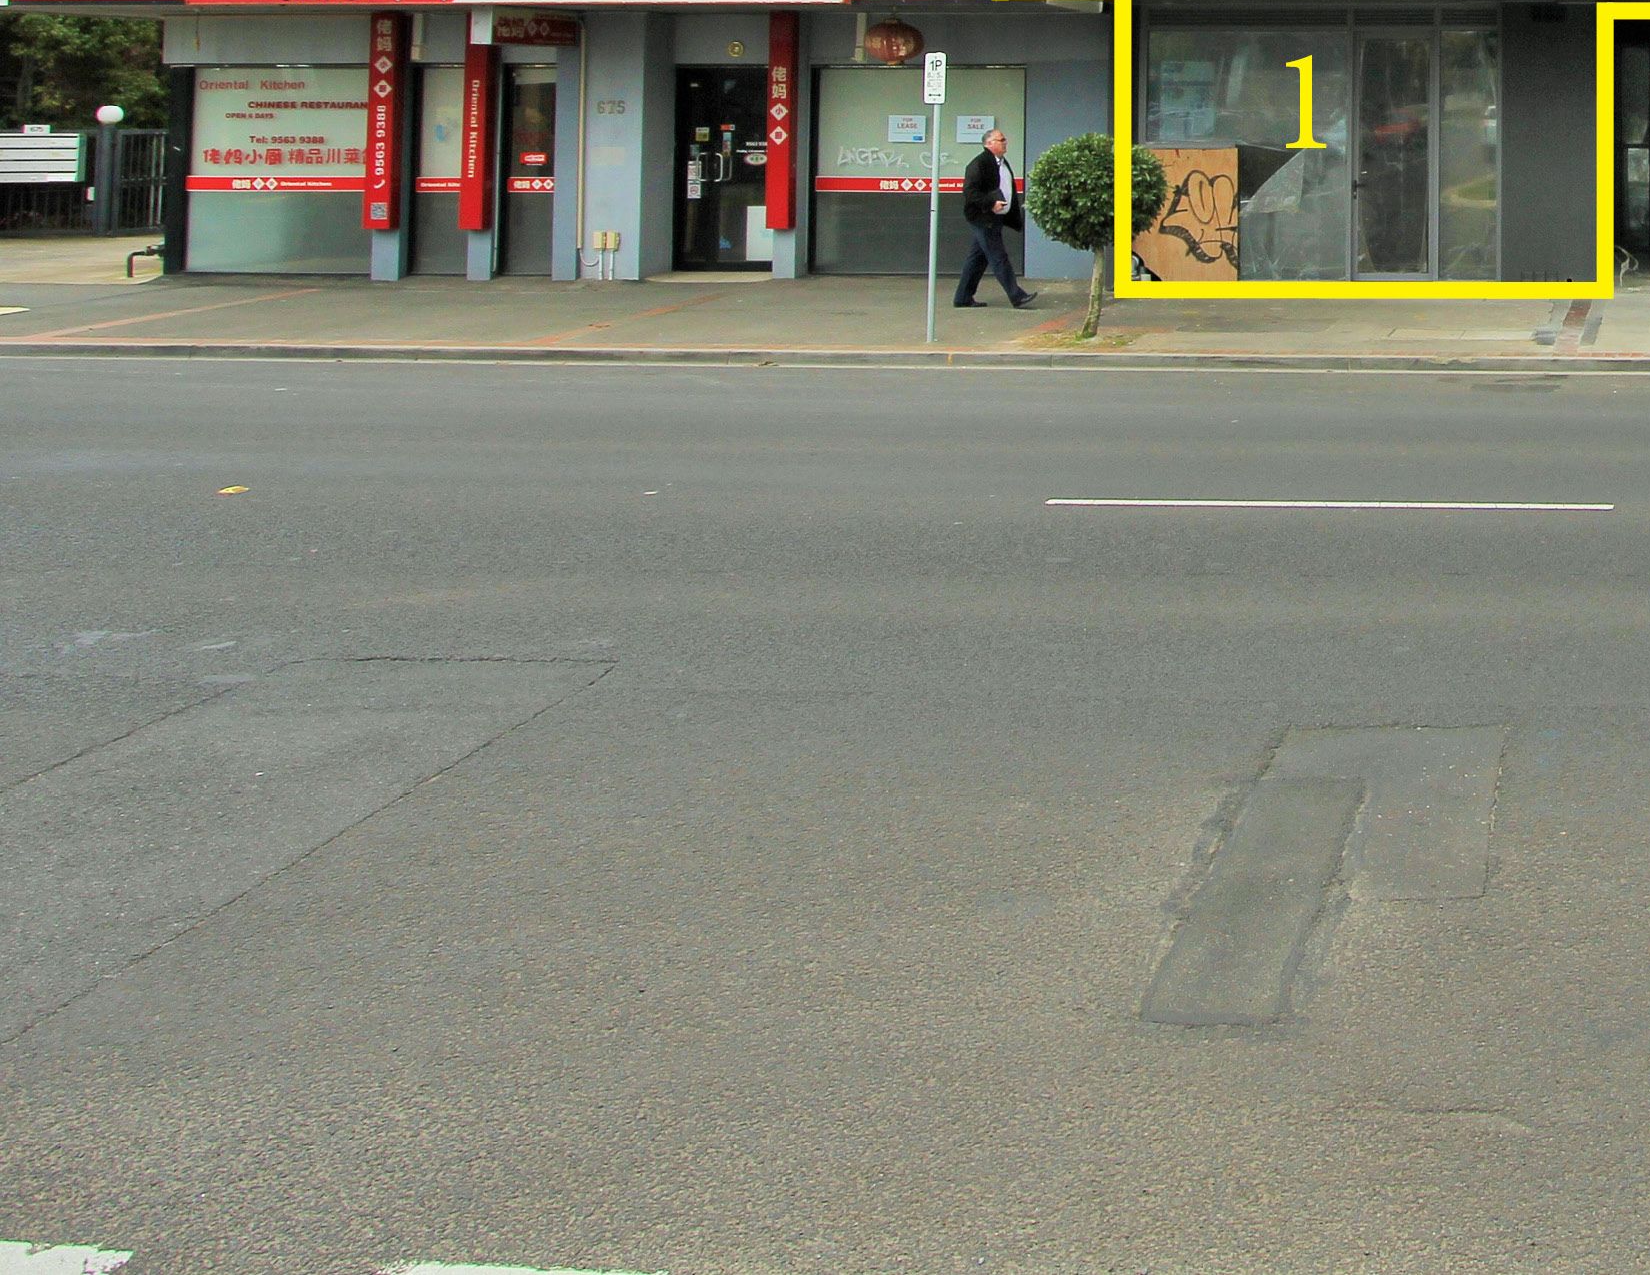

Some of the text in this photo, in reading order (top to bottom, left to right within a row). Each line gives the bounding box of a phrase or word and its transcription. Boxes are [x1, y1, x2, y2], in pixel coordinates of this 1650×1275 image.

[930, 59, 943, 71] 1P
[200, 80, 305, 91] Oriental Kitchen
[248, 101, 369, 110] CHINESE RESTAURAN
[597, 100, 626, 115] 675
[249, 136, 324, 144] Tel: 9563 9388
[375, 142, 385, 175] 9563
